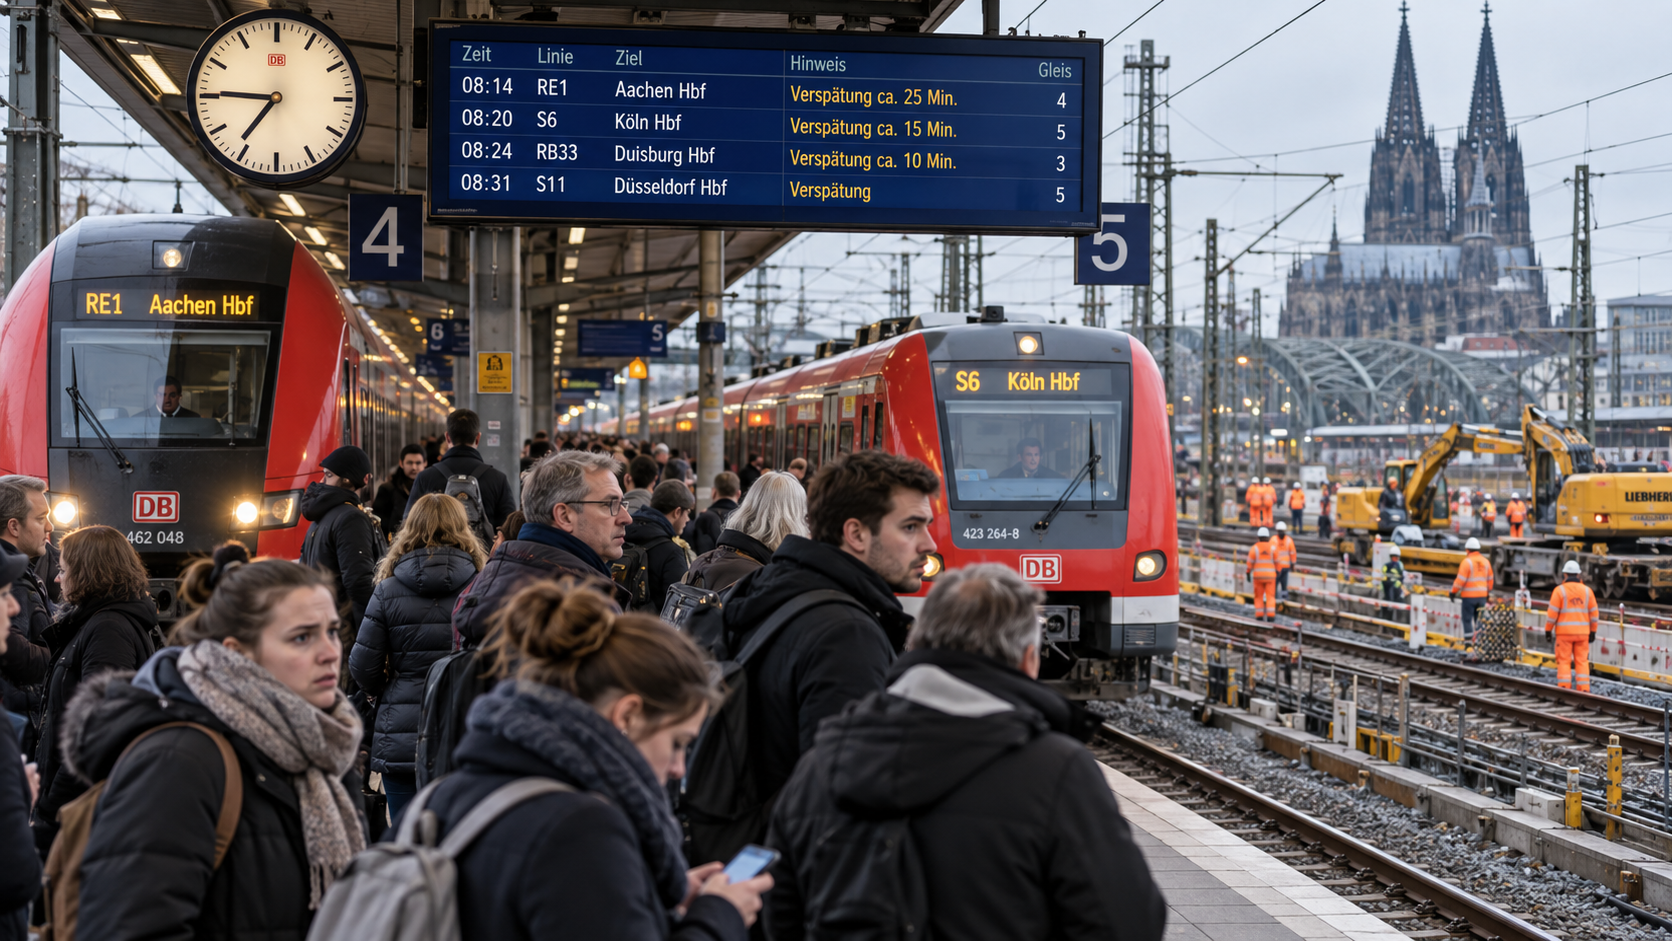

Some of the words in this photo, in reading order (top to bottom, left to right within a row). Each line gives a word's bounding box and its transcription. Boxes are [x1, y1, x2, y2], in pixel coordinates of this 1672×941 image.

[269, 55, 284, 65] DB
[462, 45, 492, 62] Zeit
[538, 48, 574, 65] Linie
[615, 50, 643, 66] Ziel
[790, 55, 847, 72] Hinweis
[1038, 62, 1072, 78] Gleis
[462, 76, 513, 94] 08:14
[537, 79, 567, 96] RE1
[615, 81, 673, 98] Aachen
[679, 83, 706, 99] Hbf
[790, 85, 872, 107] Verspätung
[877, 92, 898, 104] ca.
[904, 89, 922, 105] 25
[927, 89, 958, 106] Min.
[1057, 93, 1067, 108] 4
[462, 109, 513, 127] 08:20
[537, 111, 557, 128] S6
[615, 113, 649, 130] Köln
[654, 114, 682, 131] Hbf
[790, 117, 872, 139] Verspätung
[877, 124, 898, 136] ca.
[904, 121, 922, 137] 15
[927, 121, 957, 138] Min.
[1056, 124, 1066, 140] 5
[462, 142, 513, 159] 08:24
[537, 144, 578, 161] RB33
[615, 145, 682, 167] Duisburg
[688, 147, 715, 164] Hbf
[790, 149, 871, 171] Verspätung
[877, 156, 897, 168] ca.
[904, 153, 922, 169] 10
[927, 153, 957, 169] Min.
[1056, 156, 1066, 171] 3
[461, 174, 510, 191] 08:31
[537, 176, 564, 193] S11
[615, 177, 696, 195] Düsseldorf
[701, 179, 727, 196] Hbf
[790, 181, 871, 203] Verspätung
[1056, 187, 1065, 203] 5
[362, 206, 405, 267] 4
[1091, 214, 1128, 272] 5
[86, 293, 123, 315] RE1
[149, 294, 217, 315] Aachen
[222, 295, 255, 316] Hbf
[430, 322, 444, 341] 6
[955, 371, 981, 392] S6
[1008, 372, 1045, 391] Köln
[1050, 372, 1081, 391] Hbf
[138, 496, 174, 518] DB
[127, 531, 153, 545] 462
[156, 531, 184, 545] 048
[963, 528, 984, 540] 423
[987, 528, 1020, 540] 264-8
[1025, 559, 1056, 578] DB
